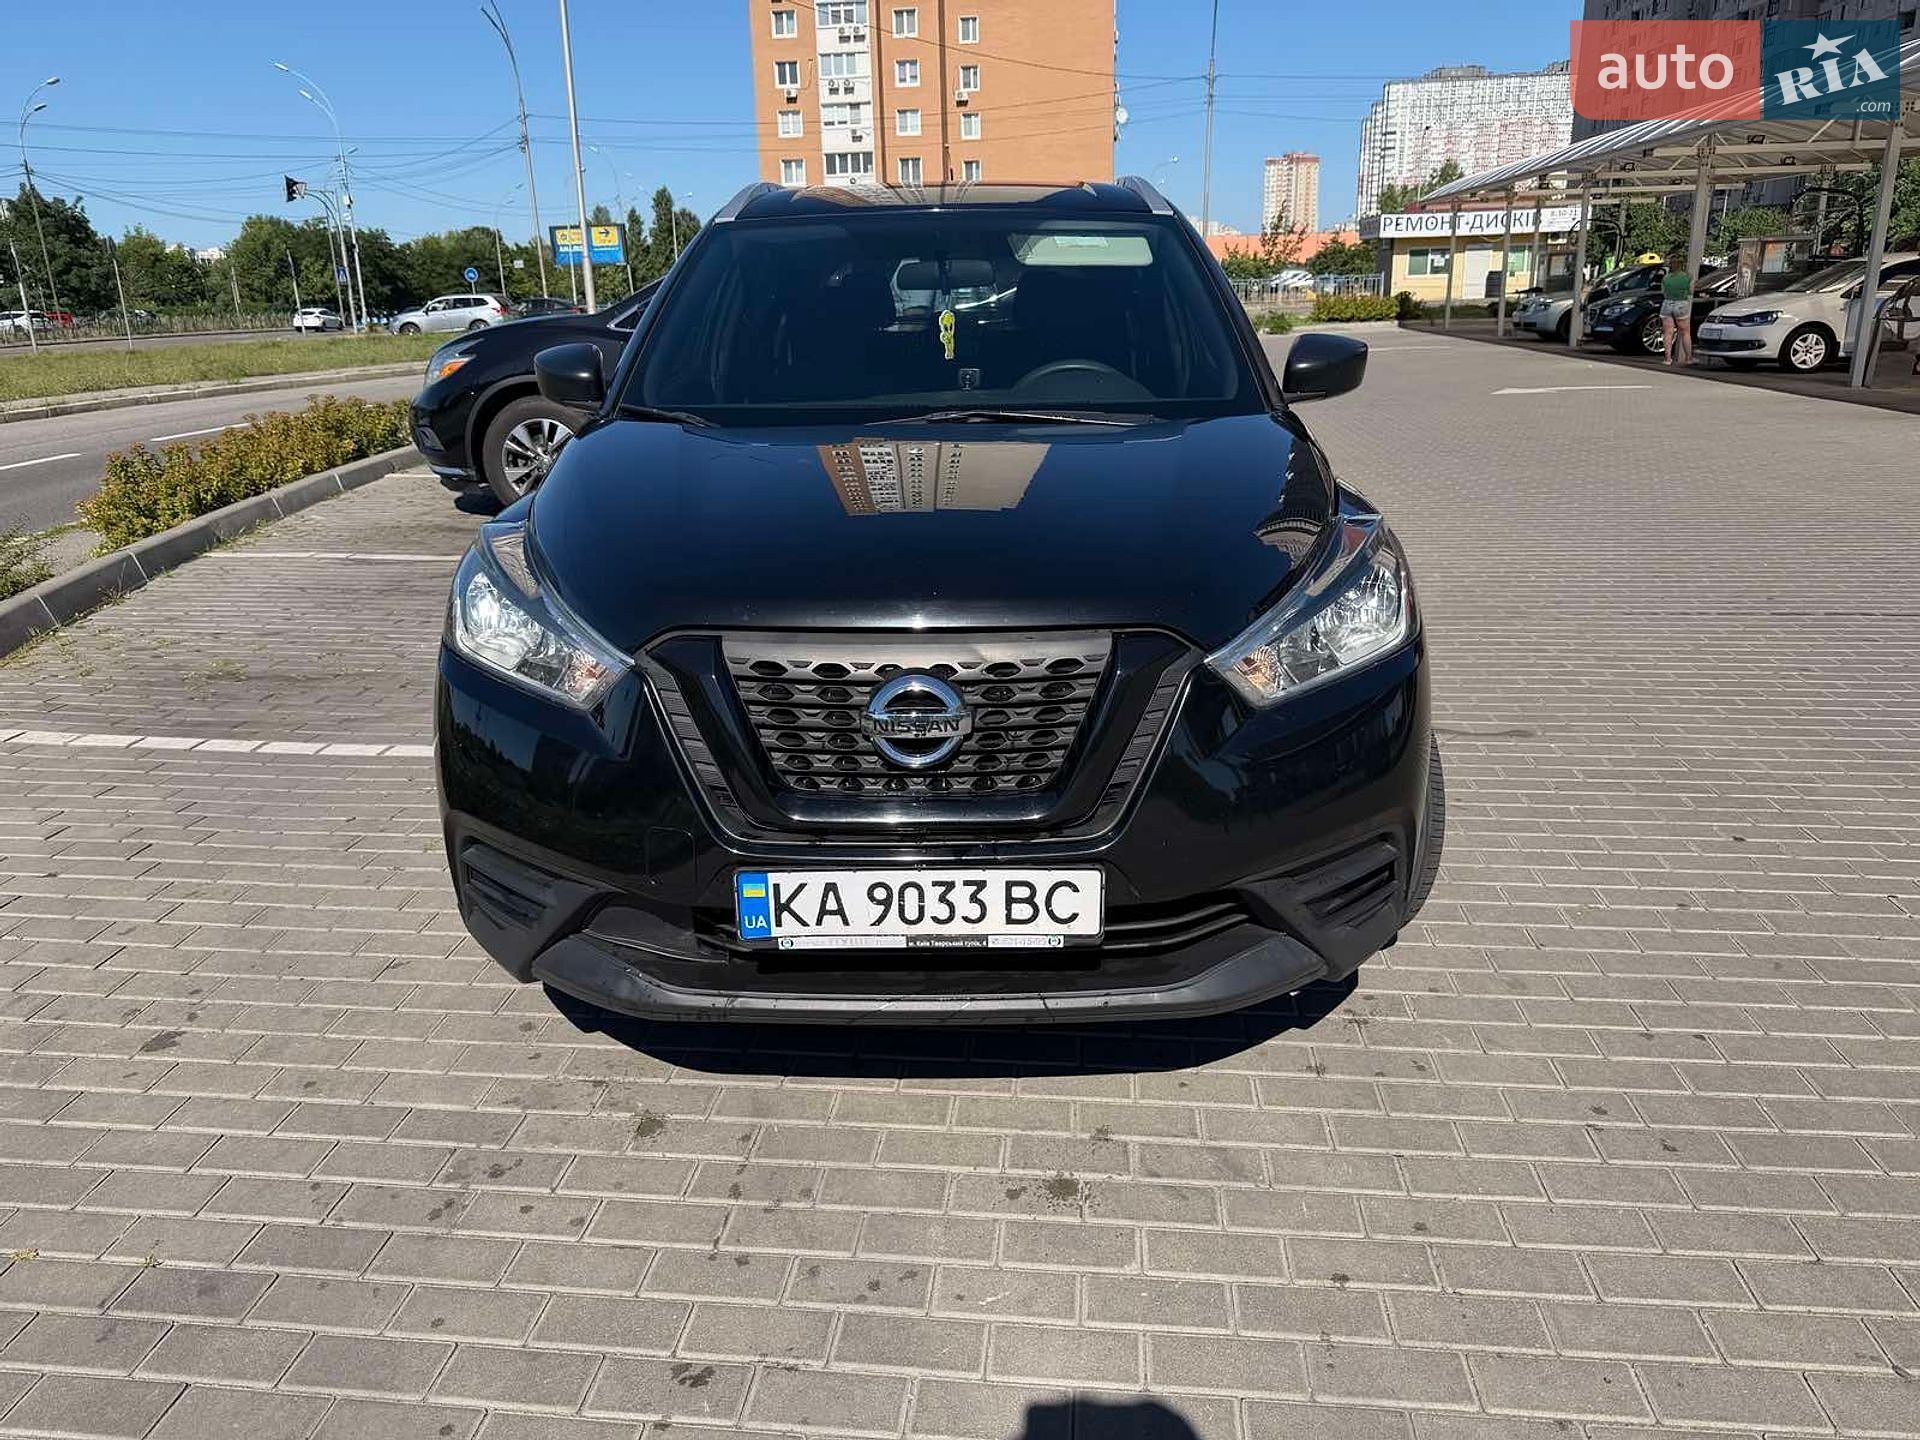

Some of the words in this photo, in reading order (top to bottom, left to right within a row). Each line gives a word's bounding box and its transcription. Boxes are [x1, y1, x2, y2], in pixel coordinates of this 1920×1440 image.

[873, 719, 960, 734] NISSAN
[772, 881, 851, 928] KA
[866, 879, 988, 927] 9033
[1004, 879, 1081, 926] BC
[745, 915, 768, 929] UA
